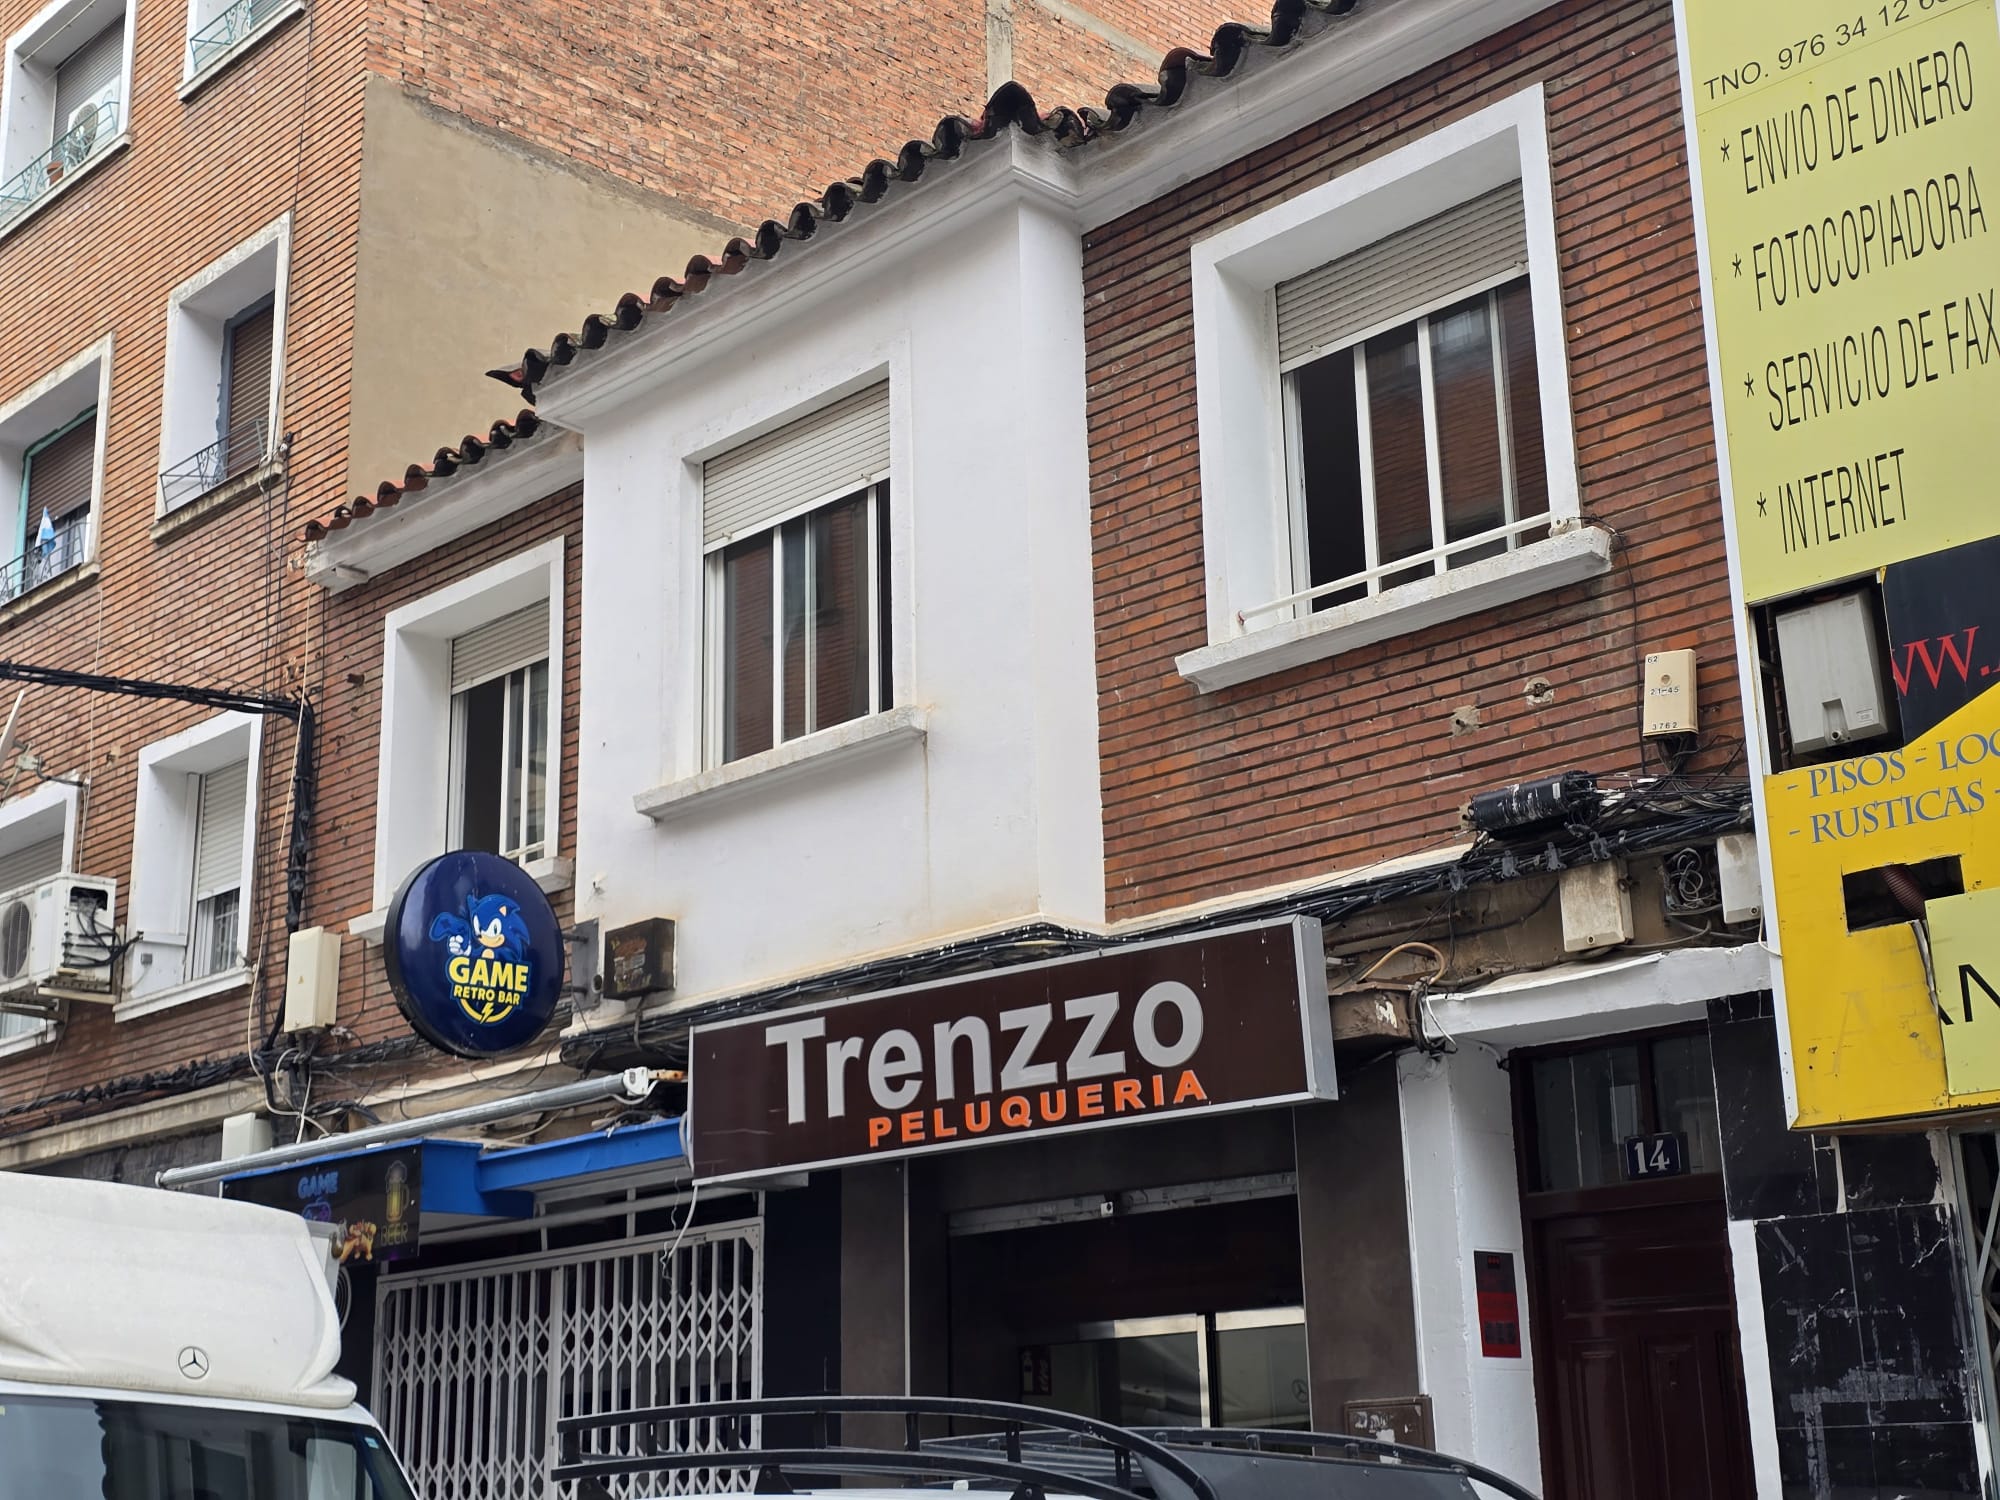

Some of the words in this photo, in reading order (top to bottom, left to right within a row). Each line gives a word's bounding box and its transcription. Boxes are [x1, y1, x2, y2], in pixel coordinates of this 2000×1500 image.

[1703, 61, 1770, 100] TNO.
[1778, 34, 1826, 70] 976
[1836, 15, 1868, 47] 34
[1879, 0, 1910, 27] 12
[1741, 103, 1818, 195] ENVIO
[1825, 84, 1864, 162] DE
[1869, 40, 1974, 145] DINERO
[1753, 165, 1988, 312] FOTOCOPIADORA
[1766, 325, 1890, 432] SERVICIO
[1898, 309, 1939, 389] DE
[1944, 287, 2000, 375] FAX
[1778, 448, 1907, 554] INTERNET
[1807, 749, 1907, 799] PISOS
[1810, 778, 1985, 844] RUSTICAS
[448, 956, 529, 993] GAME
[453, 984, 495, 1002] RETRO
[498, 990, 521, 1006] BAR
[765, 980, 1204, 1126] Trenzzo
[868, 1069, 1208, 1148] PELUQUERIA
[298, 1171, 339, 1199] GAME
[1634, 1139, 1671, 1174] 14
[380, 1222, 409, 1246] BEER
